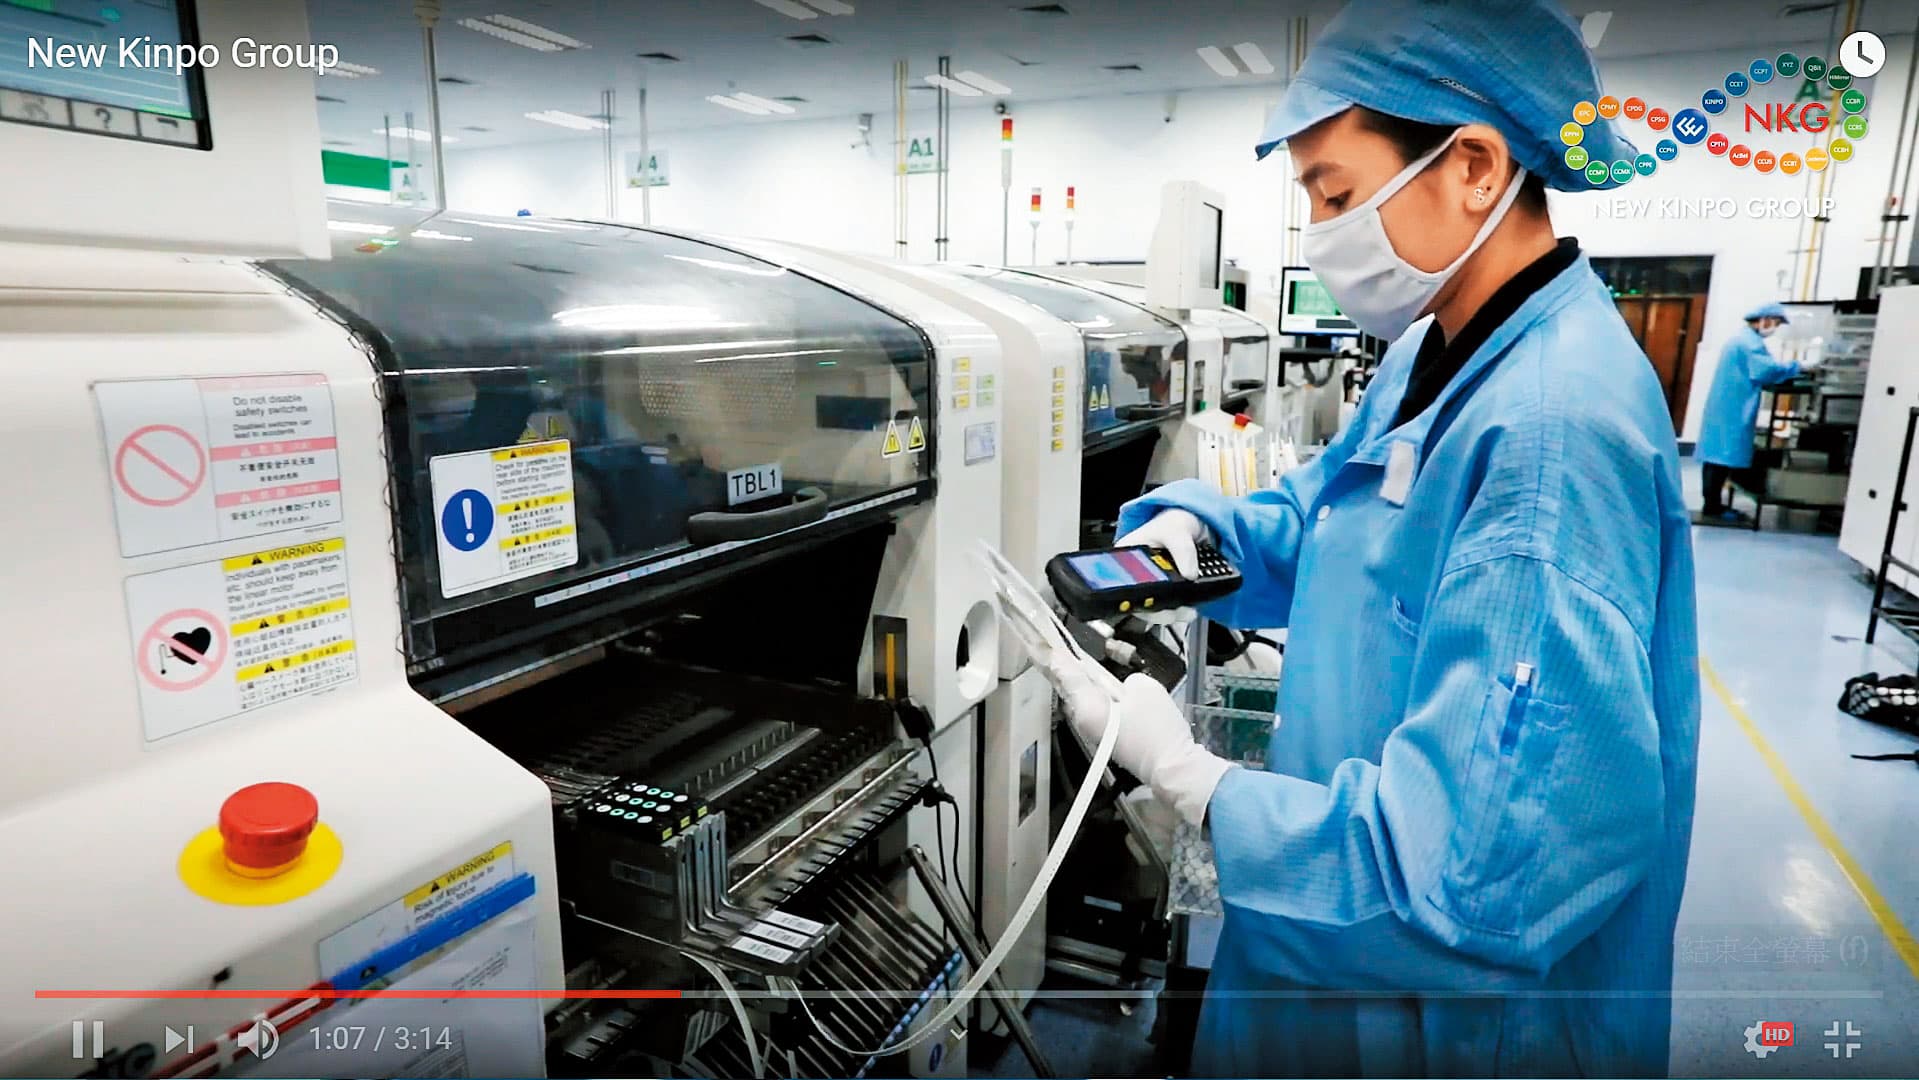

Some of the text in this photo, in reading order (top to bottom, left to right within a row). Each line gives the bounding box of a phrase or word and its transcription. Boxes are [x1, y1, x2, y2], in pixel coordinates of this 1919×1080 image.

[908, 138, 934, 158] A1
[232, 394, 303, 405] Do not disable
[235, 407, 265, 417] safety
[731, 468, 778, 497] TBL1
[268, 542, 325, 561] WARNING
[274, 563, 290, 573] with
[245, 576, 275, 589] should
[276, 572, 297, 583] keep
[446, 850, 495, 882] WARNING
